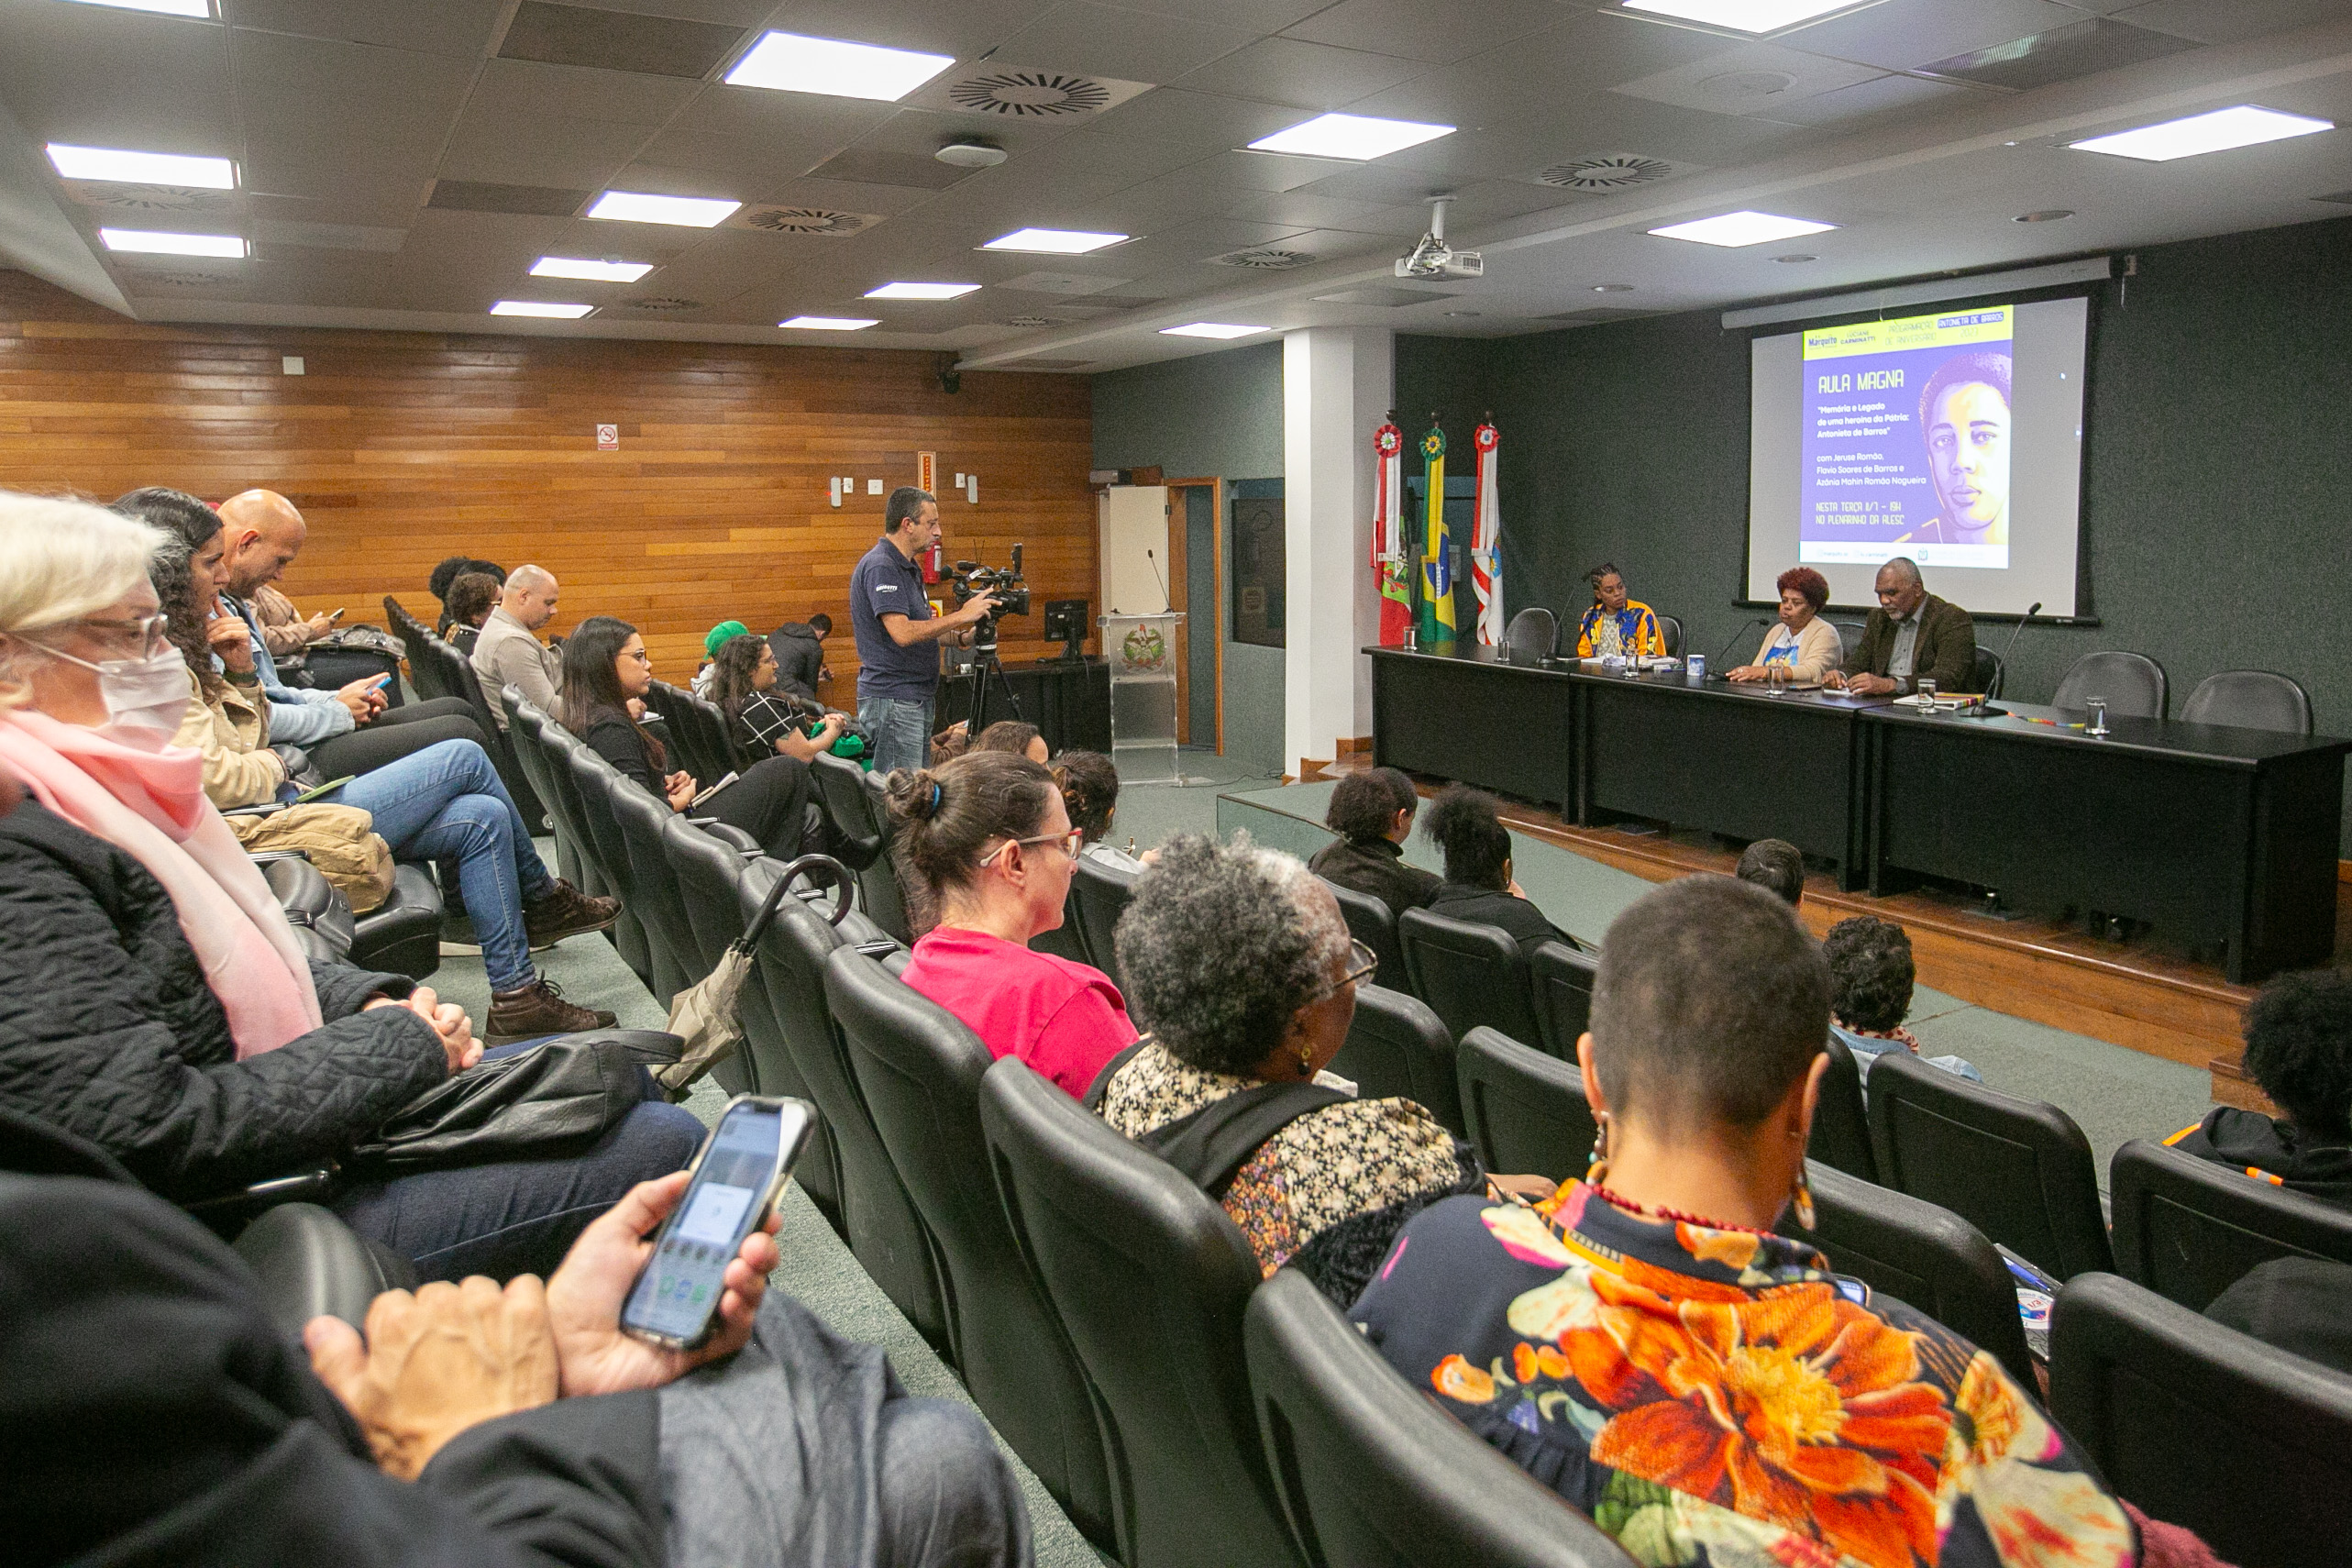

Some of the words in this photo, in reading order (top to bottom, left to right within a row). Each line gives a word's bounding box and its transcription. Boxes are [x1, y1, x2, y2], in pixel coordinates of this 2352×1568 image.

[1938, 317, 1969, 327] ANTONIETA
[1970, 315, 1980, 325] DE
[1981, 313, 2004, 324] BARROS
[1808, 337, 1838, 348] Marquito
[1840, 336, 1876, 345] CARMINATTI
[1817, 373, 1850, 394] AULA
[1857, 369, 1905, 392] MAGNA
[1817, 404, 1851, 414] "Memória
[1858, 403, 1885, 413] Legado
[1816, 418, 1827, 426] de
[1872, 414, 1883, 423] da
[1884, 413, 1909, 422] Pátria:
[1816, 428, 1852, 438] Antonieta
[1852, 428, 1862, 436] de
[1863, 426, 1891, 436] Barros"
[1833, 454, 1856, 462] Jeruse
[1856, 452, 1884, 461] Romão,
[1838, 465, 1862, 474] Soares
[1862, 465, 1872, 473] de
[1873, 464, 1898, 473] Barros
[1840, 477, 1863, 486] Mahin
[1864, 477, 1891, 485] Romão
[1892, 476, 1927, 487] Nogueira
[1816, 502, 1838, 512] NESTA
[1840, 501, 1863, 513] TERÇA
[1816, 514, 1826, 525] NO
[1827, 514, 1867, 525] PLENARINHO
[1869, 514, 1880, 525] DA
[1882, 514, 1905, 525] ALESC
